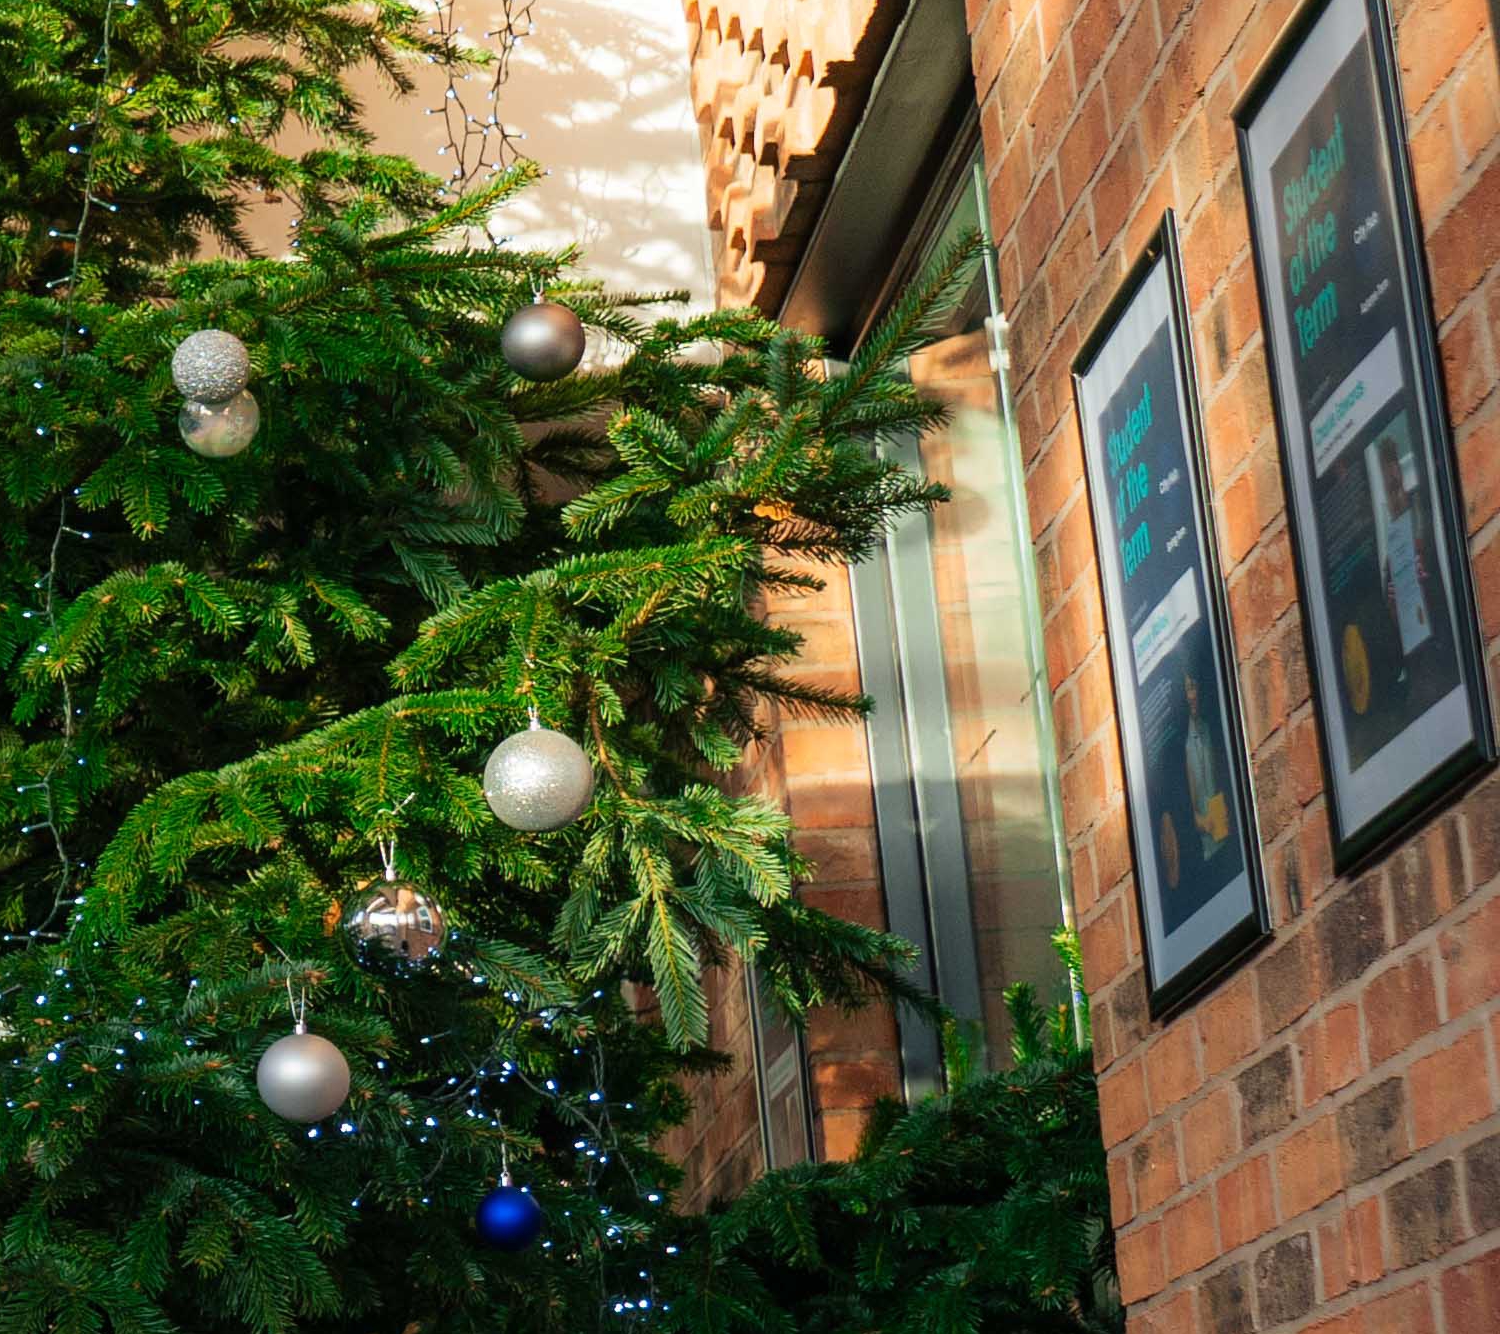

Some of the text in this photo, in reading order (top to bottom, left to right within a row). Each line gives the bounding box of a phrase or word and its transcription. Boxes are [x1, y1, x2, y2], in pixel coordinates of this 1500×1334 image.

[1283, 112, 1345, 236] Student
[1290, 234, 1306, 297] of
[1307, 210, 1337, 274] the
[1294, 281, 1338, 357] Term
[1107, 381, 1153, 479] Student
[1115, 478, 1127, 530] of
[1127, 462, 1149, 514] the
[1119, 521, 1151, 583] Term
